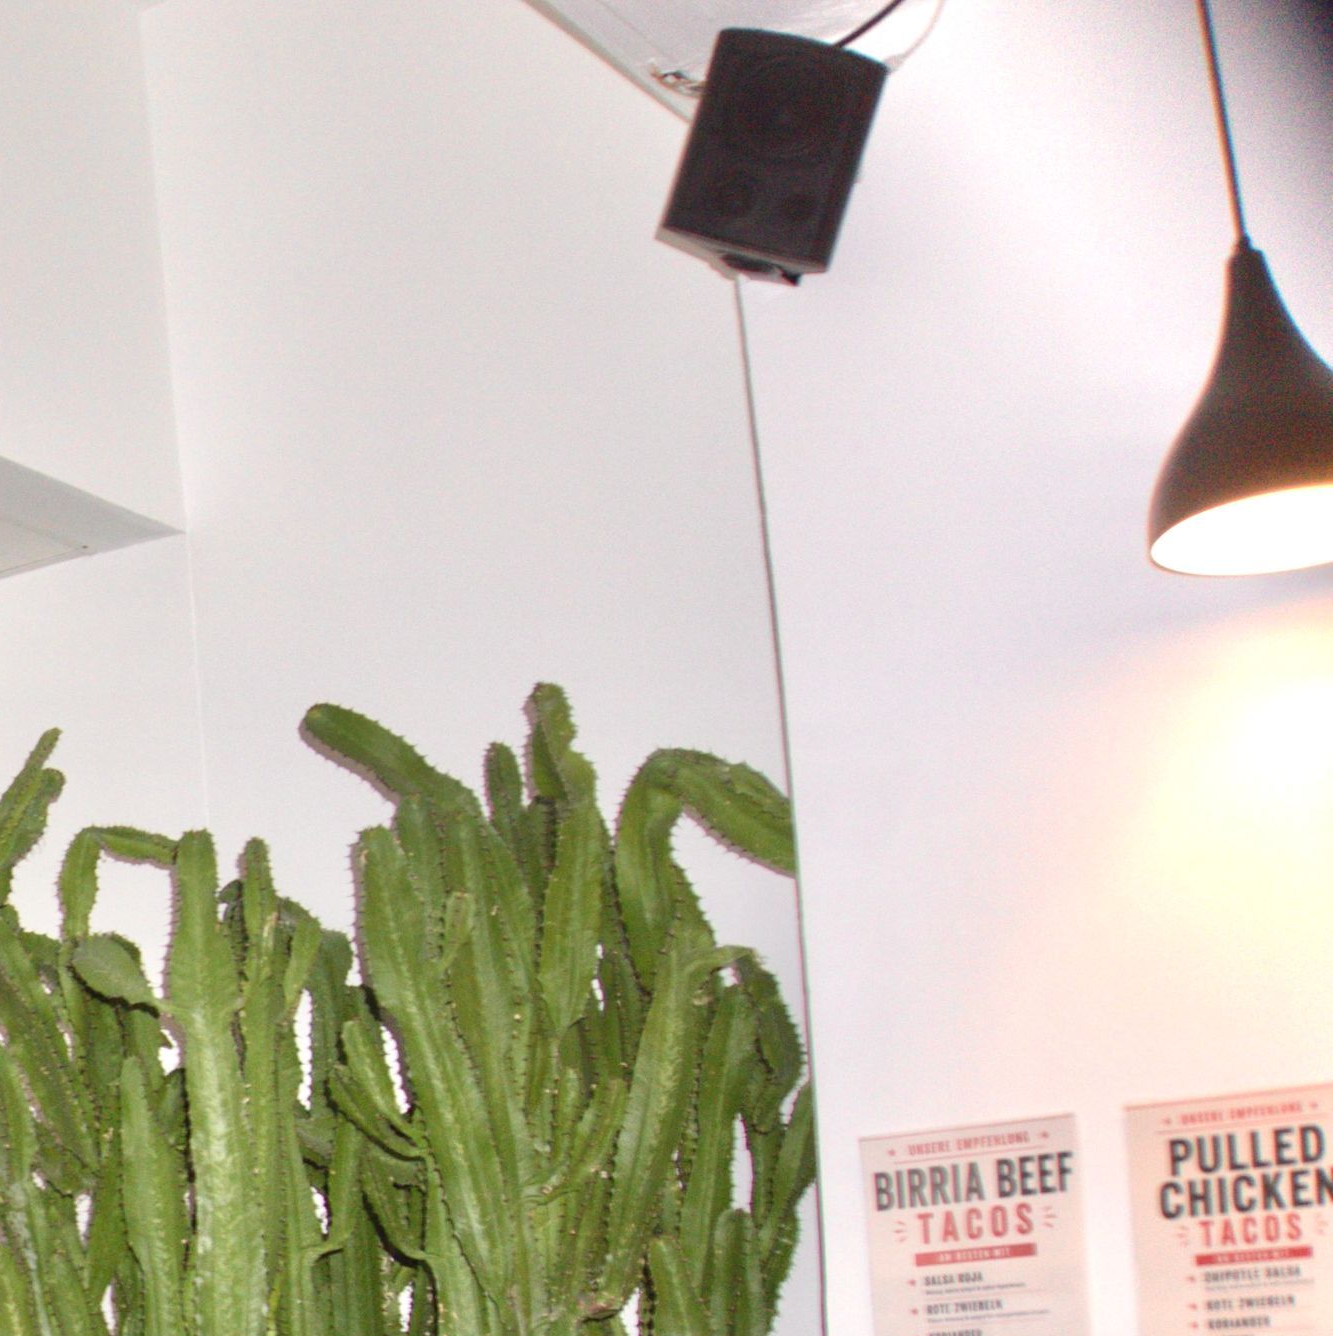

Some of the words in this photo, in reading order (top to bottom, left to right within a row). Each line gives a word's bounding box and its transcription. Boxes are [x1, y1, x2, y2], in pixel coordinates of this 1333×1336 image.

[1169, 1124, 1325, 1177] PULLED
[874, 1161, 986, 1211] BIRRIA
[997, 1151, 1073, 1199] BEEF
[1159, 1167, 1333, 1219] CHICKEN
[917, 1203, 1034, 1244] TACOS
[1199, 1213, 1303, 1248] TACOS
[924, 1274, 954, 1287] SALSA
[954, 1299, 1003, 1314] ZWIEBELN
